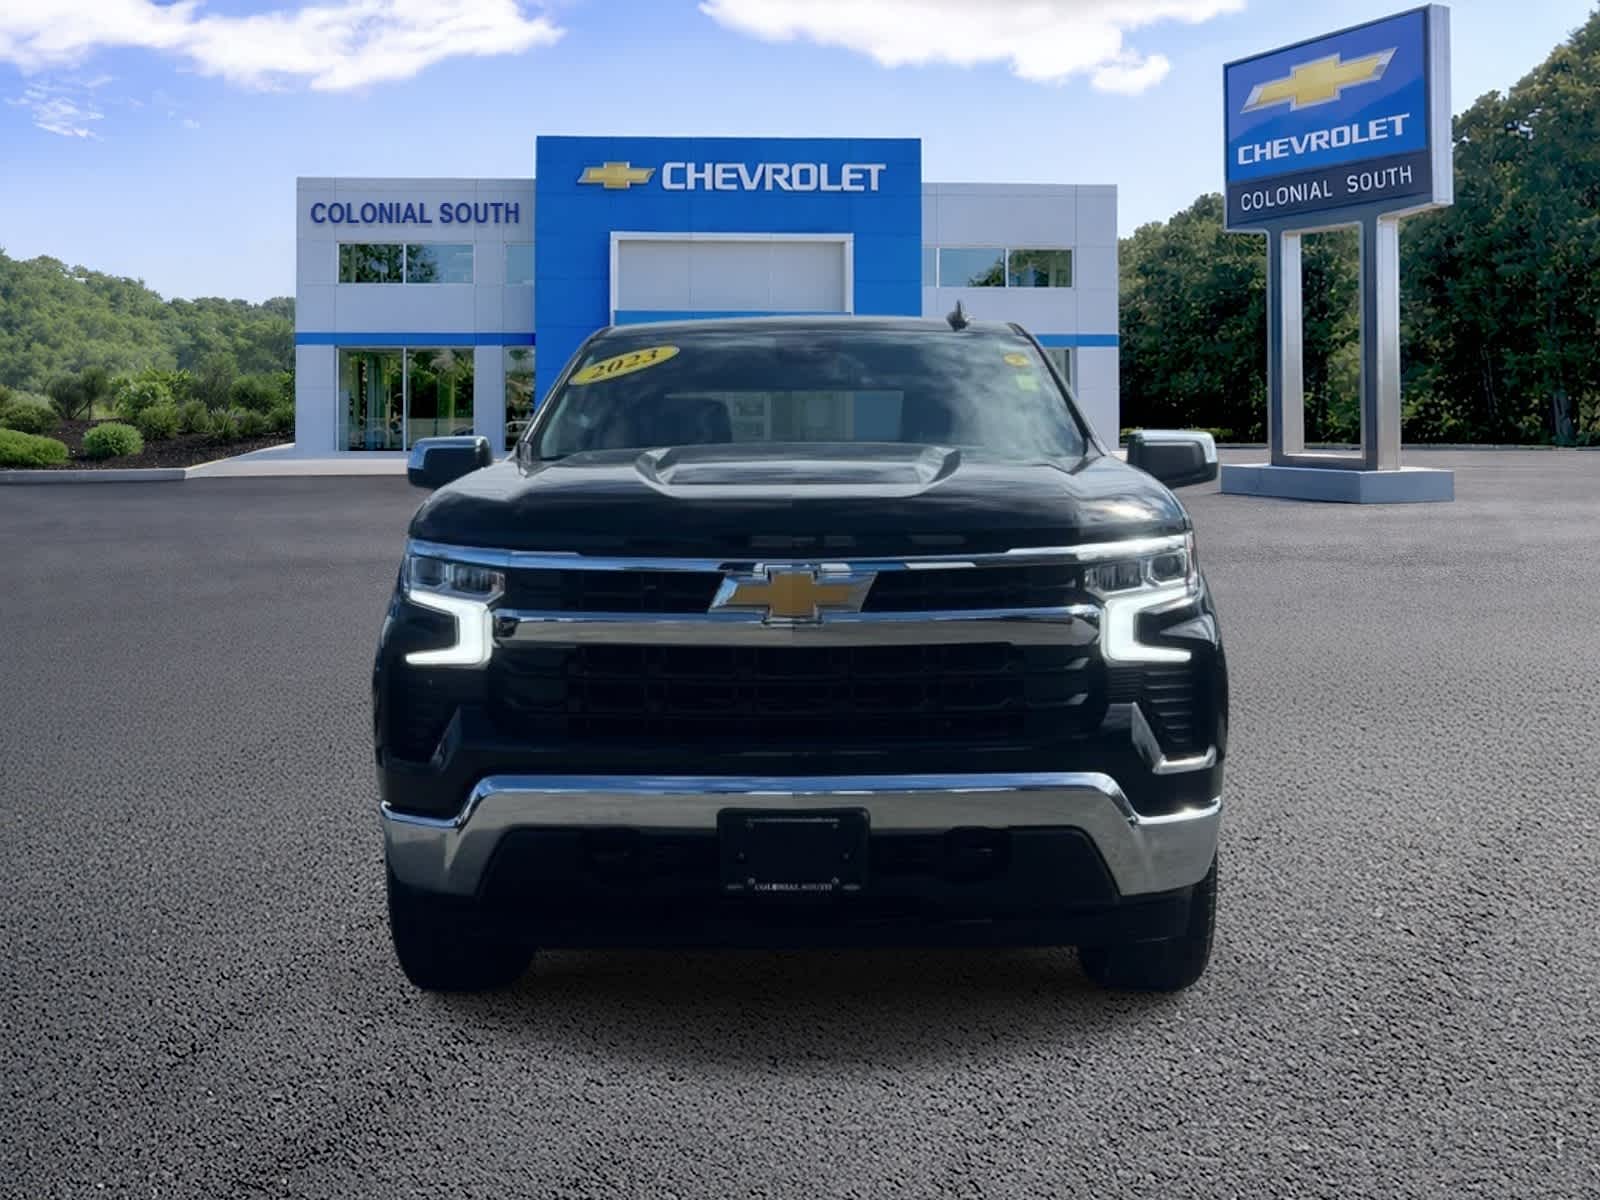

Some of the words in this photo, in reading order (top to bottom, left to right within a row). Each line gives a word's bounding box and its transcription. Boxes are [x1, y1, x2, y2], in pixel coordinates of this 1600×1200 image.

[1237, 113, 1410, 165] CHEVROLET
[662, 161, 887, 192] CHEVROLET
[1241, 180, 1333, 211] COLONIAL
[1347, 165, 1412, 193] SOUTH
[310, 202, 432, 224] COLONIAL
[439, 202, 520, 224] SOUTH
[591, 349, 658, 379] 2023
